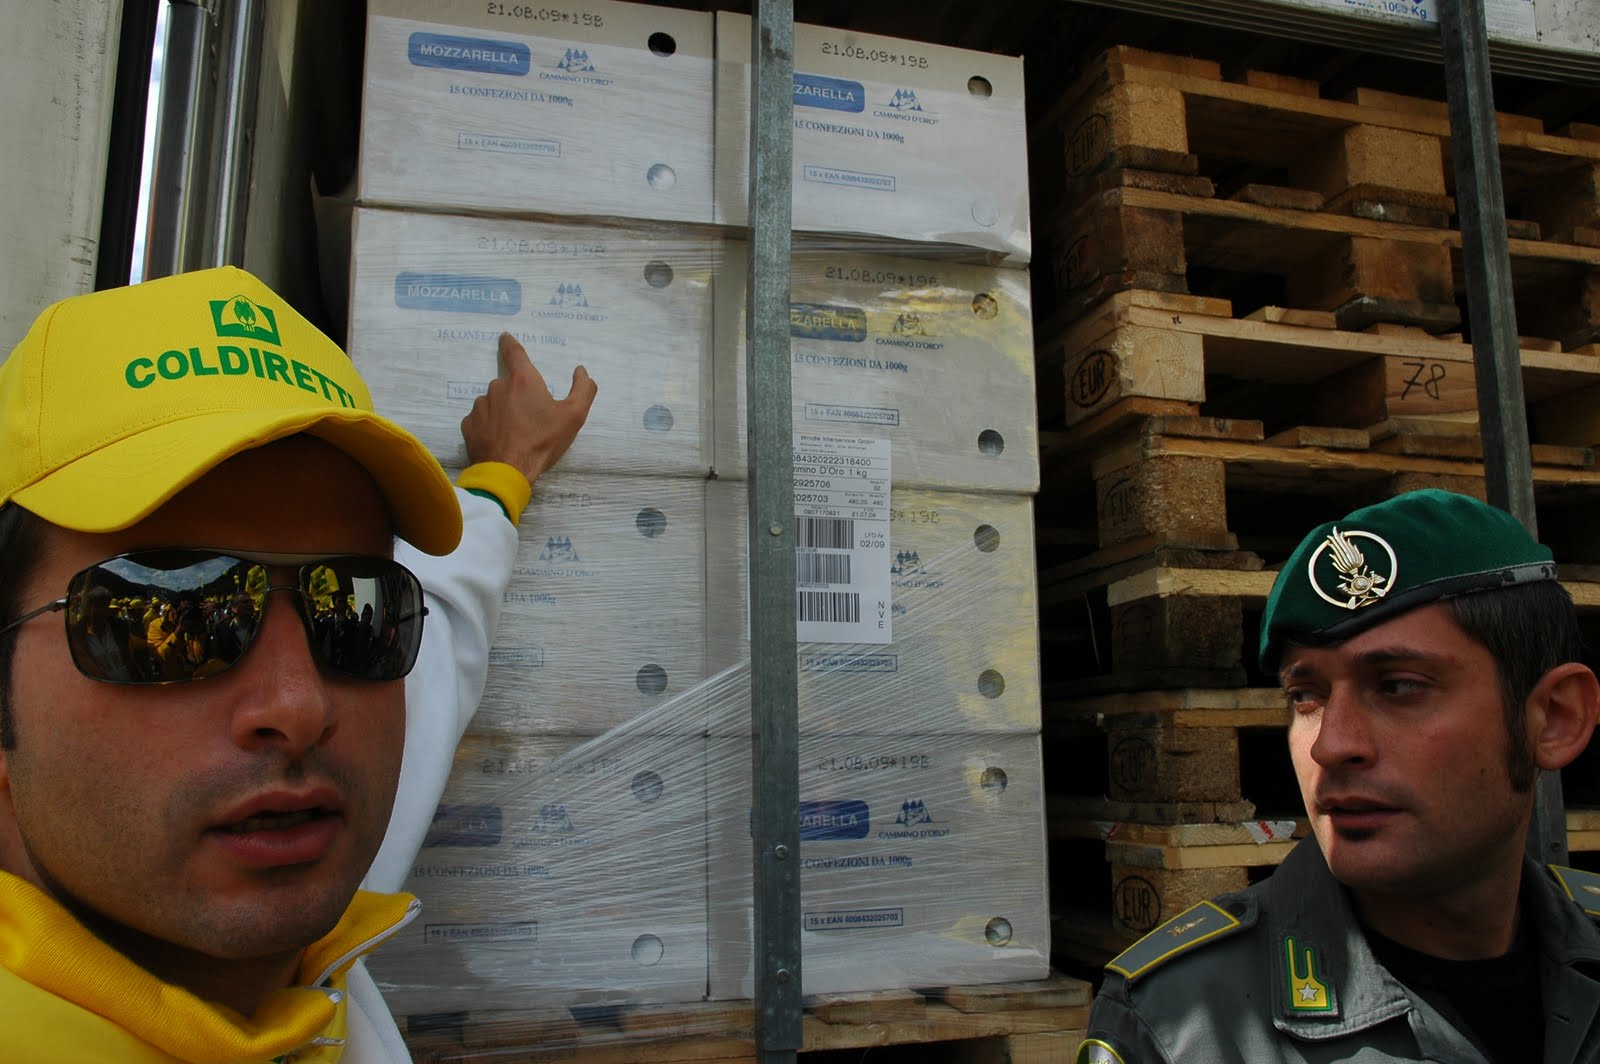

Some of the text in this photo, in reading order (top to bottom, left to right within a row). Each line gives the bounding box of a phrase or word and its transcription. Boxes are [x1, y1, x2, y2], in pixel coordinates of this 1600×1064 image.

[1411, 5, 1427, 20] Kg
[420, 43, 519, 65] MOZZARELLA
[539, 71, 581, 83] CAMMINO
[449, 85, 574, 107] 15 CONFEZIONI DA 1000g
[793, 83, 855, 102] ZARELLA
[873, 110, 911, 121] CAMMINO
[794, 120, 905, 144] 15 CONFEZIONI DA 1000g
[824, 172, 840, 180] EAN
[407, 284, 509, 303] MOZZARELLA
[522, 332, 537, 343] DA
[541, 333, 567, 346] 1000g
[876, 338, 914, 348] CAMMINO
[794, 353, 908, 373] 15 CONFEZIONI DA 1000g
[125, 345, 356, 409] COLDIRETTI
[1401, 362, 1446, 400] 78
[819, 466, 845, 476] D'Oro
[857, 468, 868, 479] kg
[860, 540, 885, 548] 02/09
[800, 814, 858, 827] ARELLA
[878, 831, 919, 839] CAMMINO
[805, 854, 913, 869] CONFEZIONI DA 1000g
[1122, 887, 1152, 925] EUR
[810, 917, 819, 926] 15
[826, 916, 843, 925] EAN
